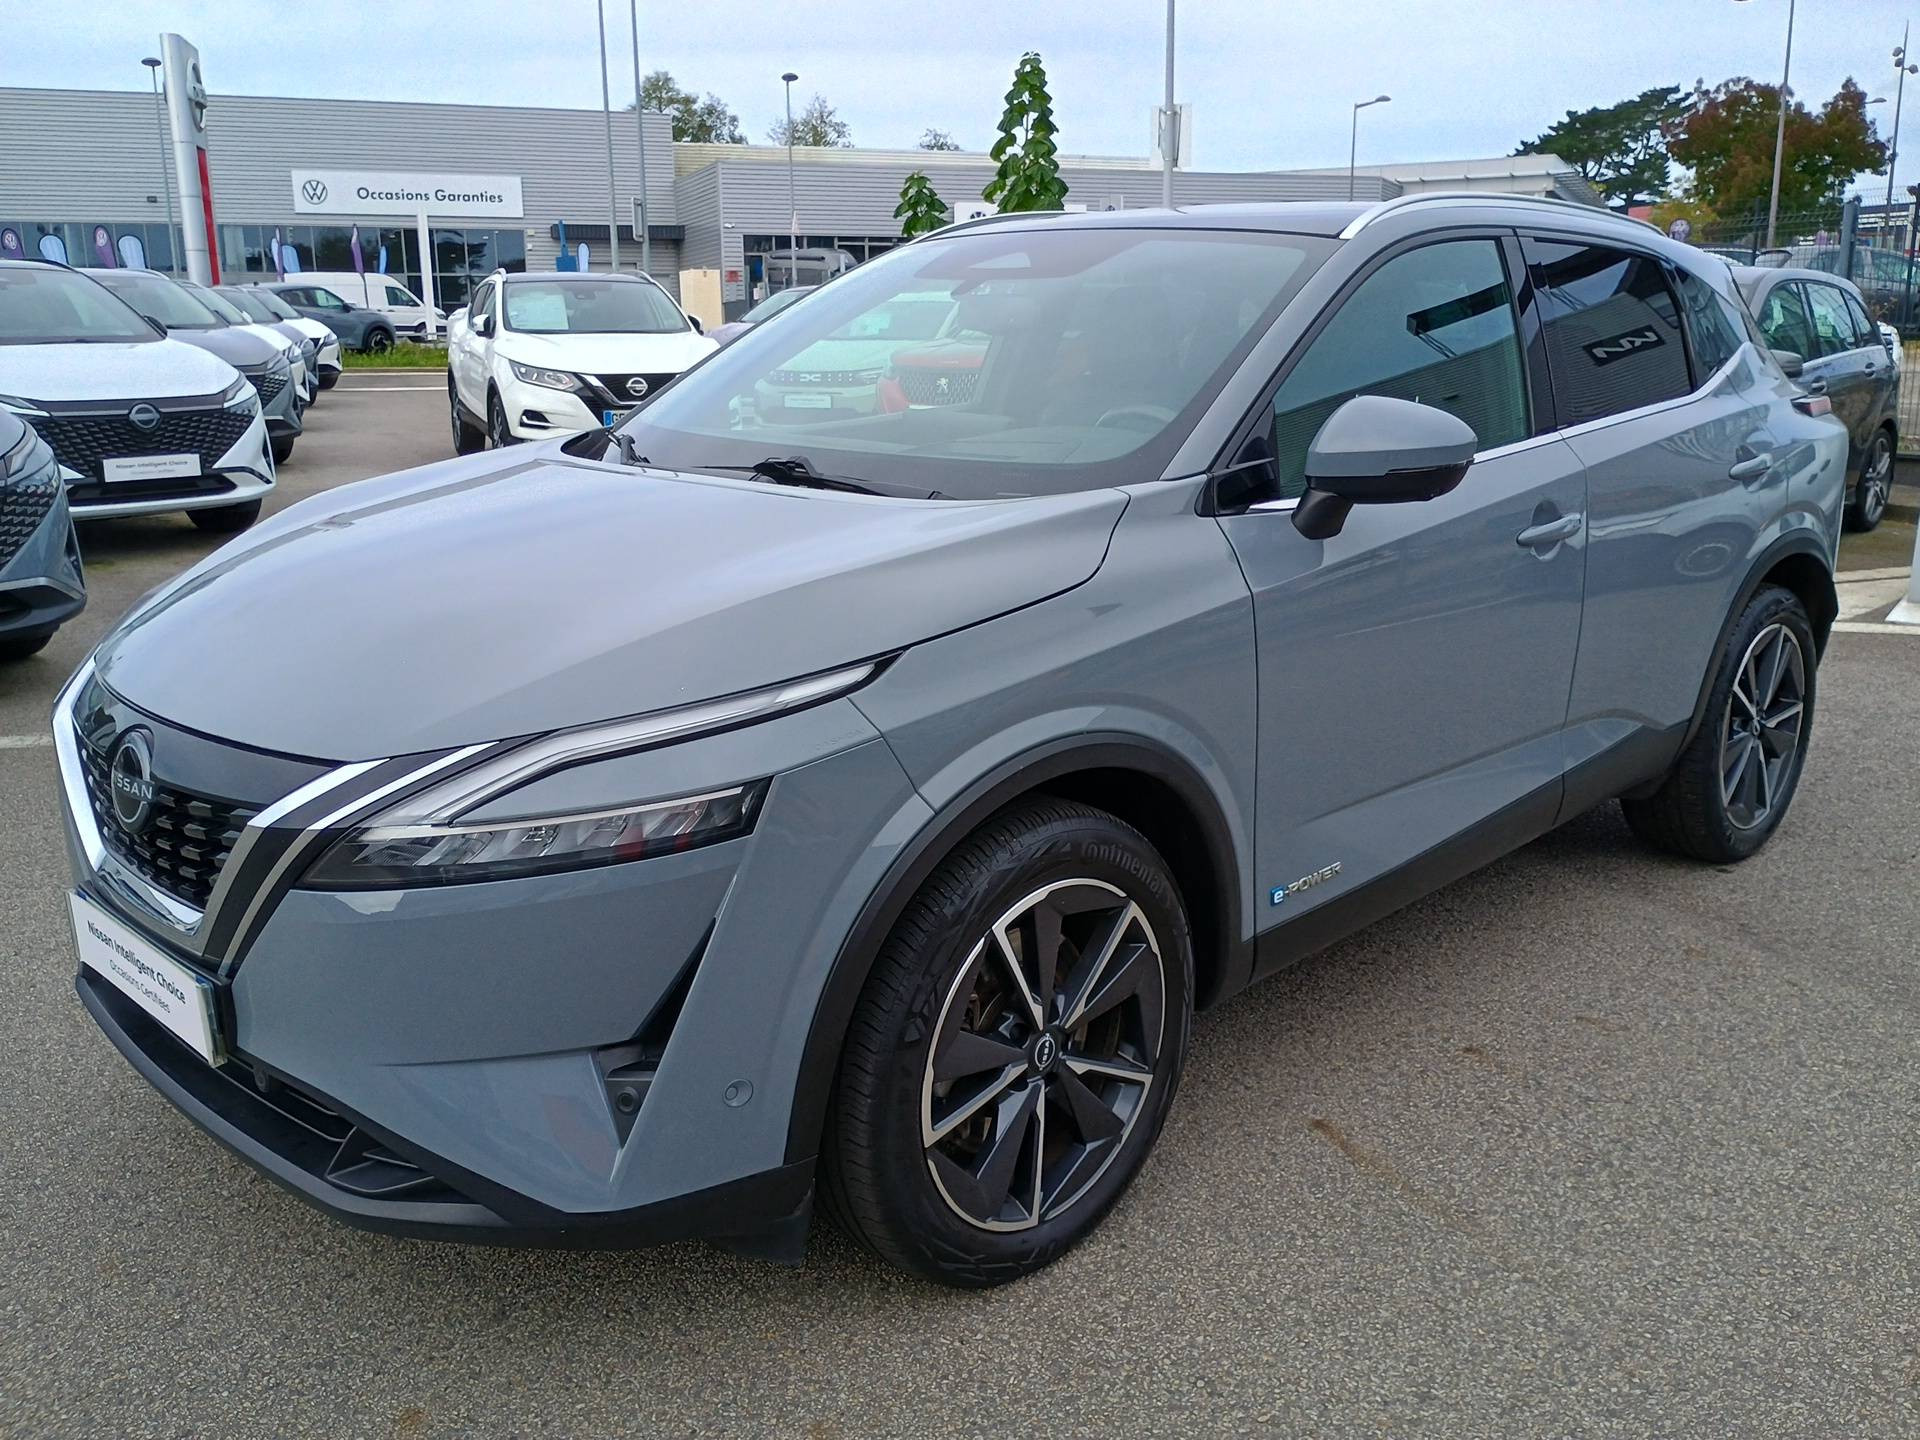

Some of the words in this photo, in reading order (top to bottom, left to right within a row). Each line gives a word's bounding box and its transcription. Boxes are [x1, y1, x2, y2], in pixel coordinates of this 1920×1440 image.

[356, 187, 430, 201] Occasions
[434, 188, 503, 203] Garanties
[1272, 861, 1343, 905] e-POWER
[87, 919, 115, 951] Nissan
[114, 938, 156, 982] Intelligent
[156, 971, 186, 1004] Choice
